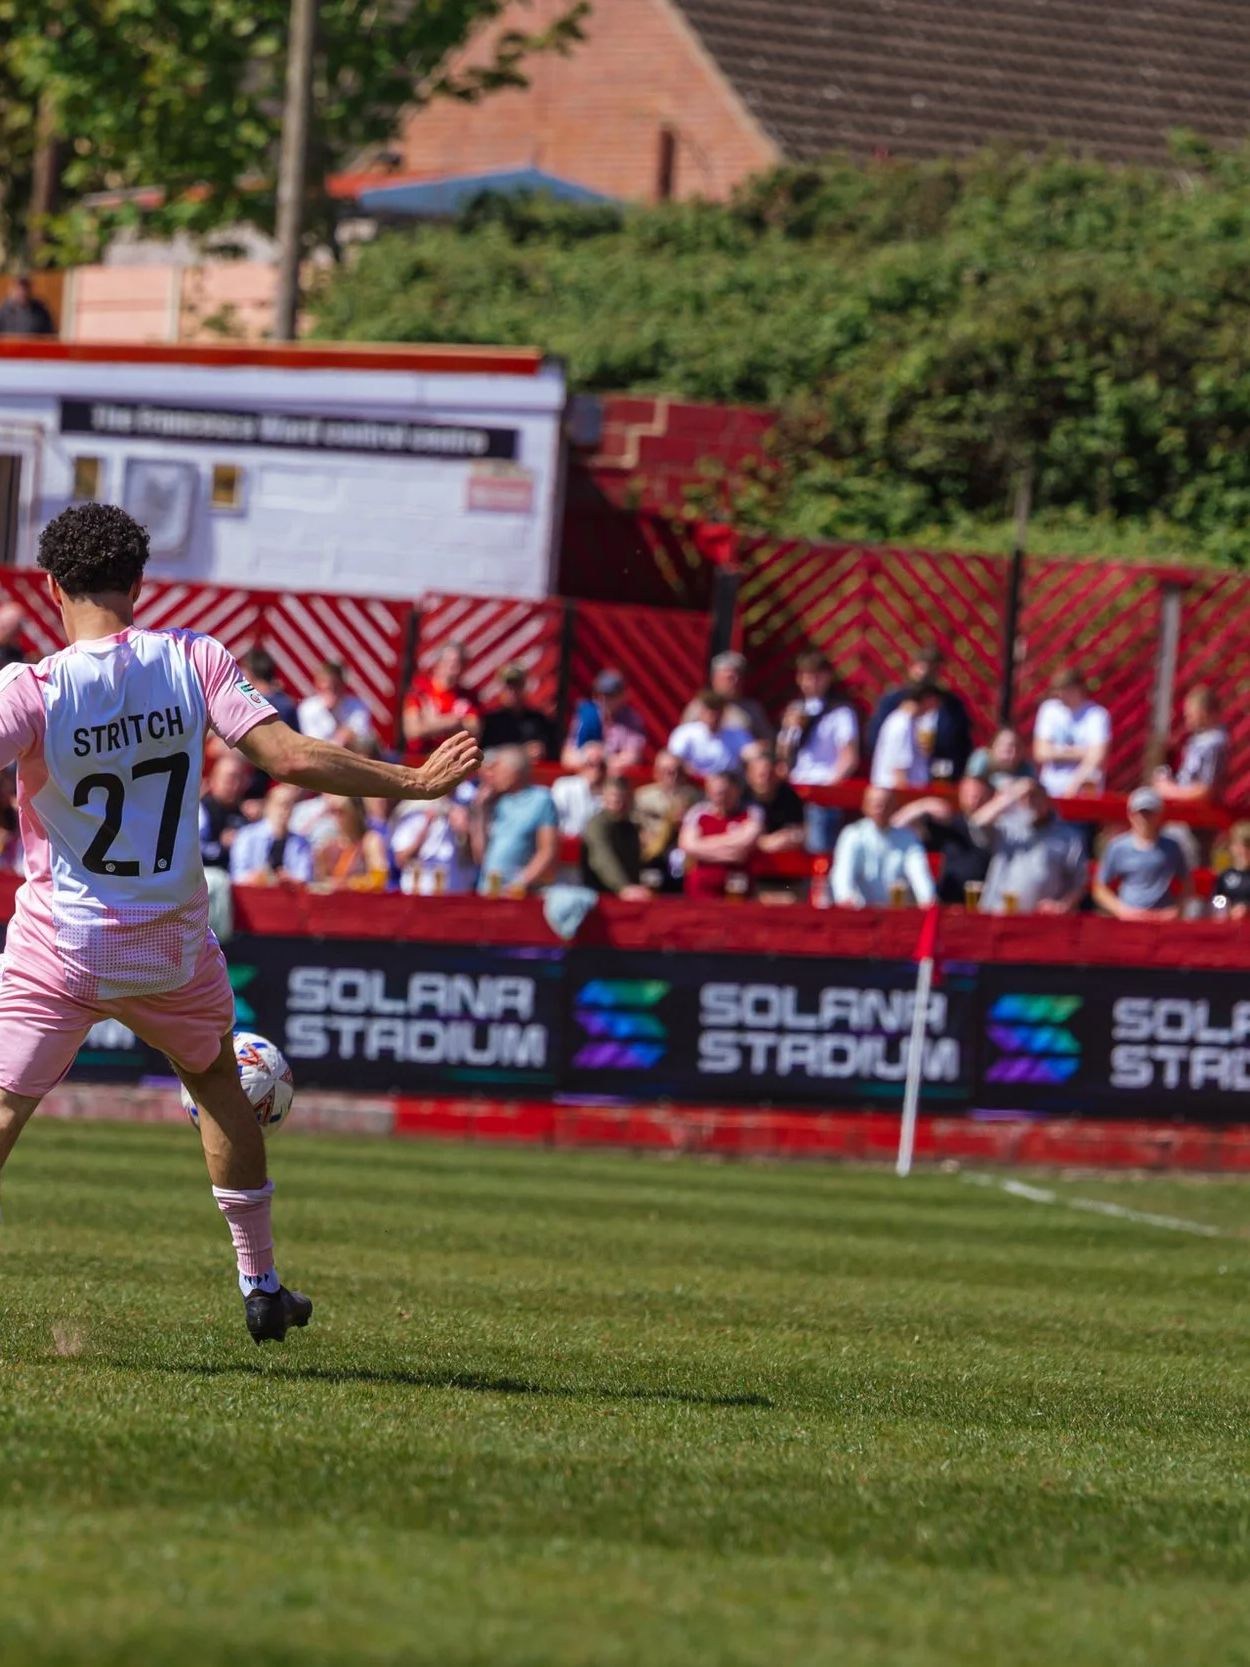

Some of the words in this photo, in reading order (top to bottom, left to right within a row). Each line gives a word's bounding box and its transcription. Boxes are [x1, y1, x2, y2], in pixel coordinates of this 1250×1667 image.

[73, 706, 184, 757] STRITCH
[73, 751, 190, 877] 27
[287, 966, 535, 1020] SOLANA
[700, 982, 948, 1034] SOLANA
[285, 1014, 547, 1068] STADIUM
[698, 1030, 960, 1082] STADIUM
